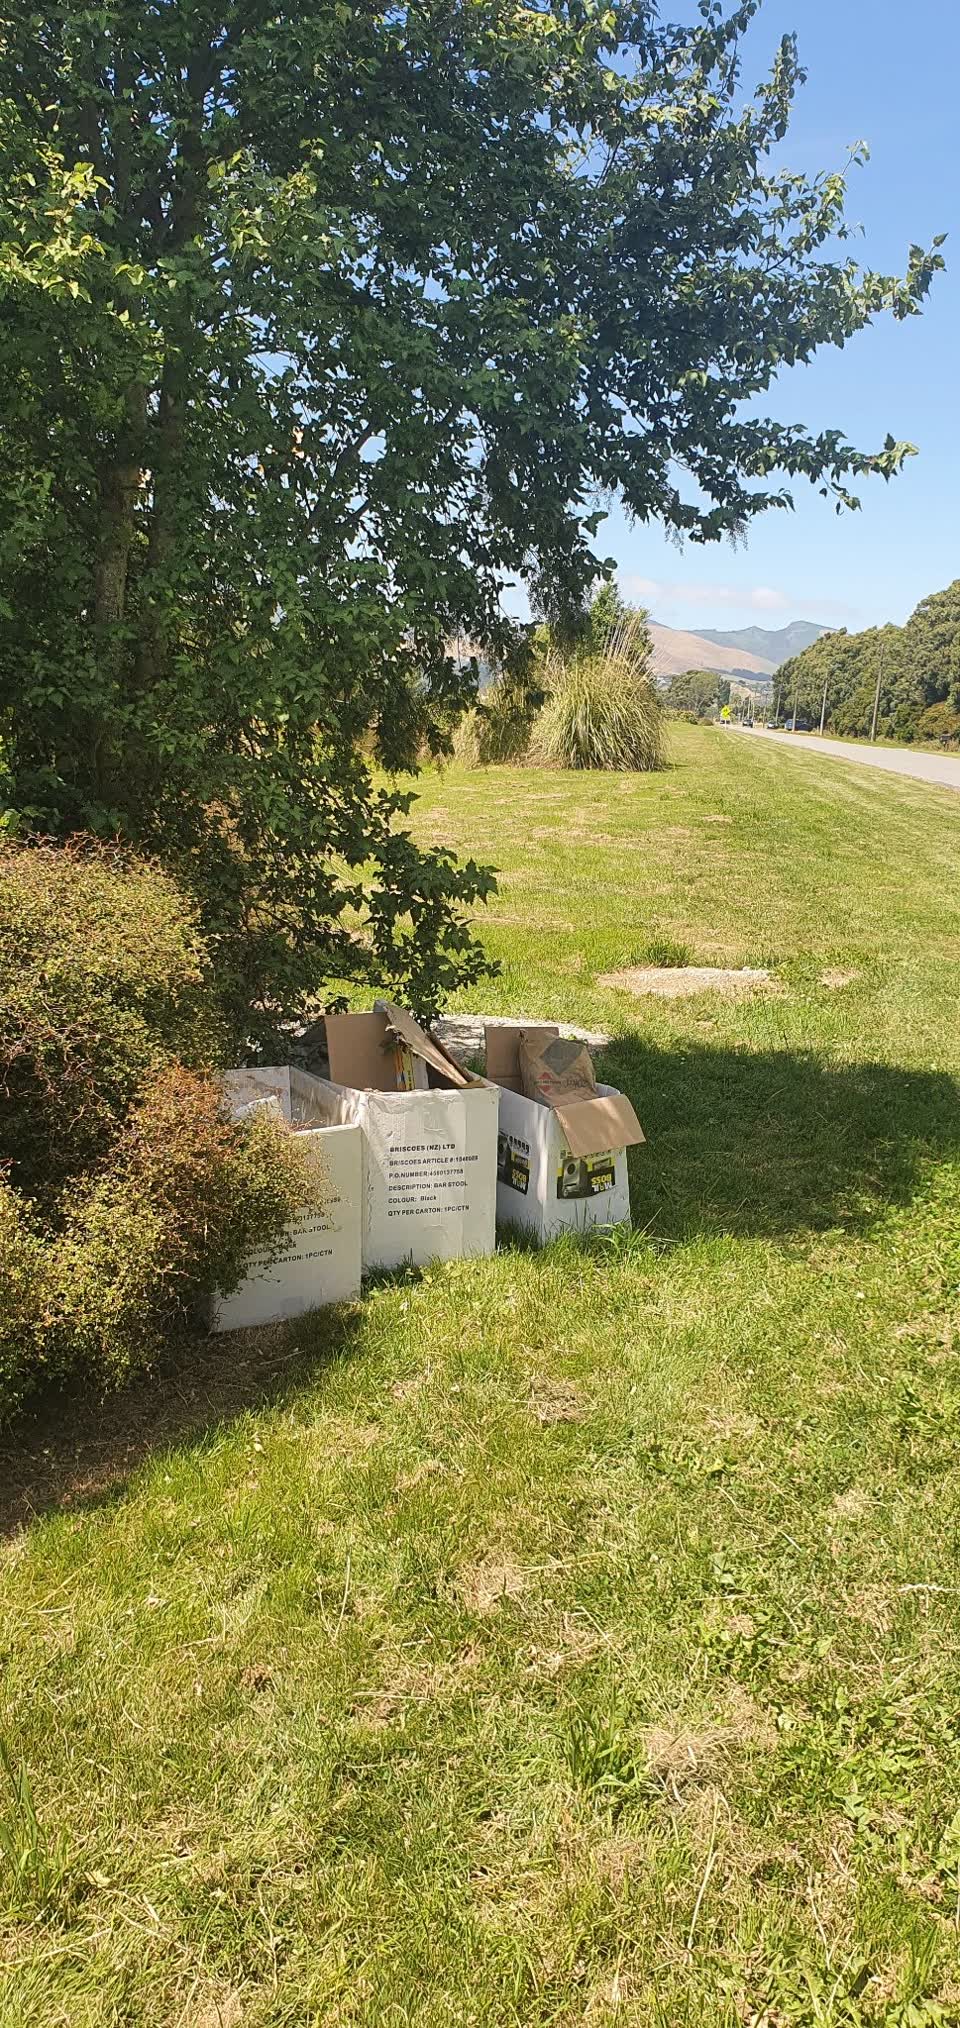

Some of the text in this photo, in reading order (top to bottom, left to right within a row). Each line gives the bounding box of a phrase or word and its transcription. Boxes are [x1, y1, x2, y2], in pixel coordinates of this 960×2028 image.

[389, 1145, 426, 1153] BRISCOES
[426, 1144, 441, 1152] (NZ)
[389, 1158, 422, 1166] BRISCOES
[422, 1157, 449, 1165] ARTICLE
[590, 1173, 612, 1185] BOSS
[388, 1183, 433, 1191] DESCRIPTION:
[447, 1180, 468, 1188] STOOL
[388, 1196, 417, 1204] COLOUR:
[415, 1207, 443, 1215] CARTON:
[273, 1254, 304, 1265] CARTON:
